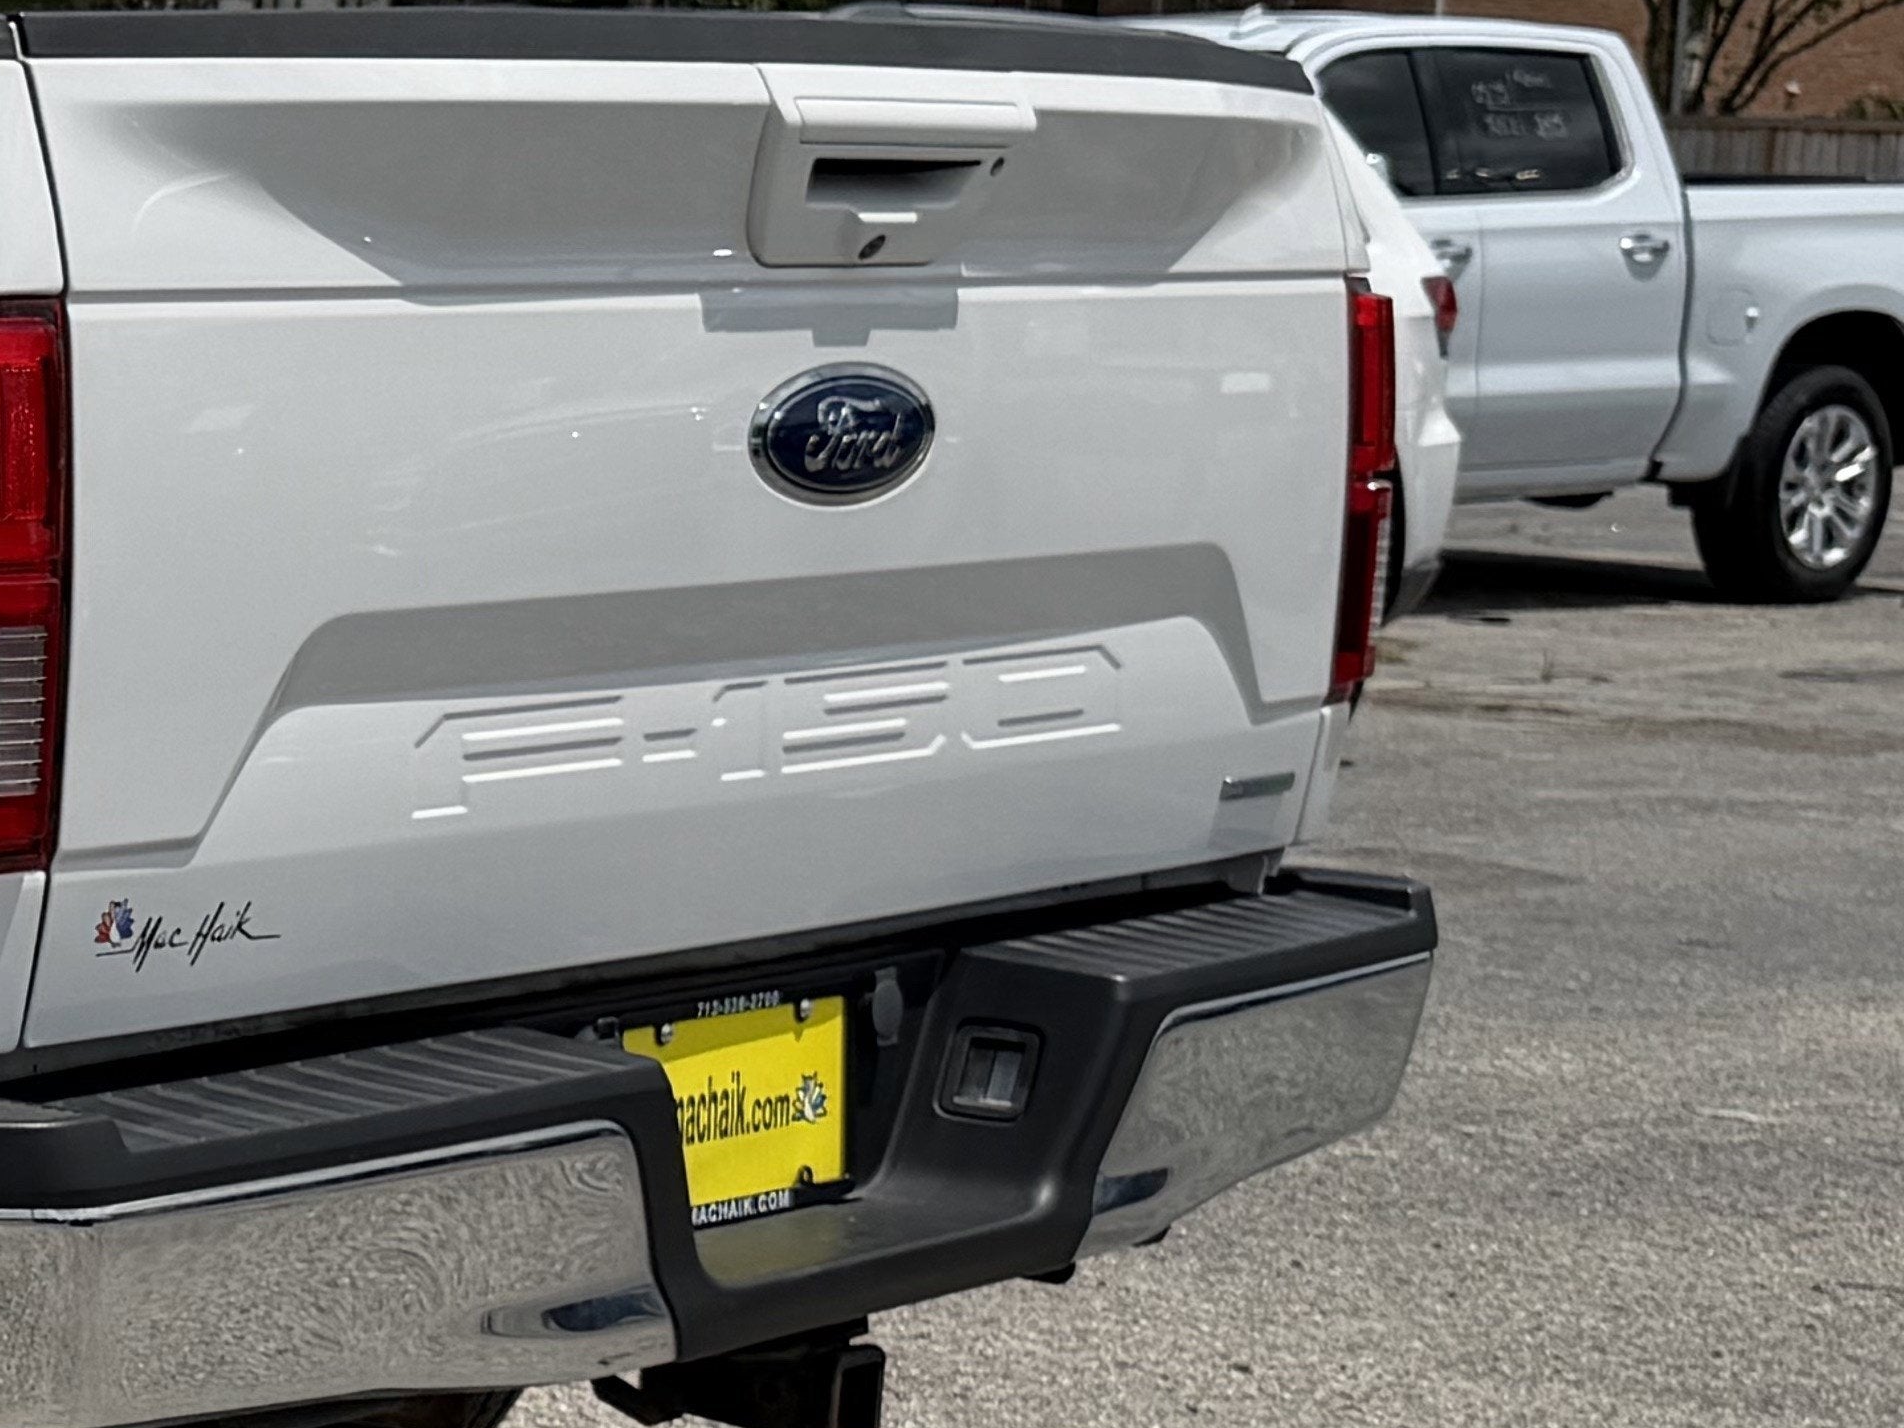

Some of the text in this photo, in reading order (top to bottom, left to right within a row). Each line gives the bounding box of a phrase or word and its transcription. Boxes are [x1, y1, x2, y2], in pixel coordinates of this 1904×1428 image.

[804, 395, 902, 472] Ford
[411, 644, 1121, 819] F-150
[188, 901, 281, 966] Haik
